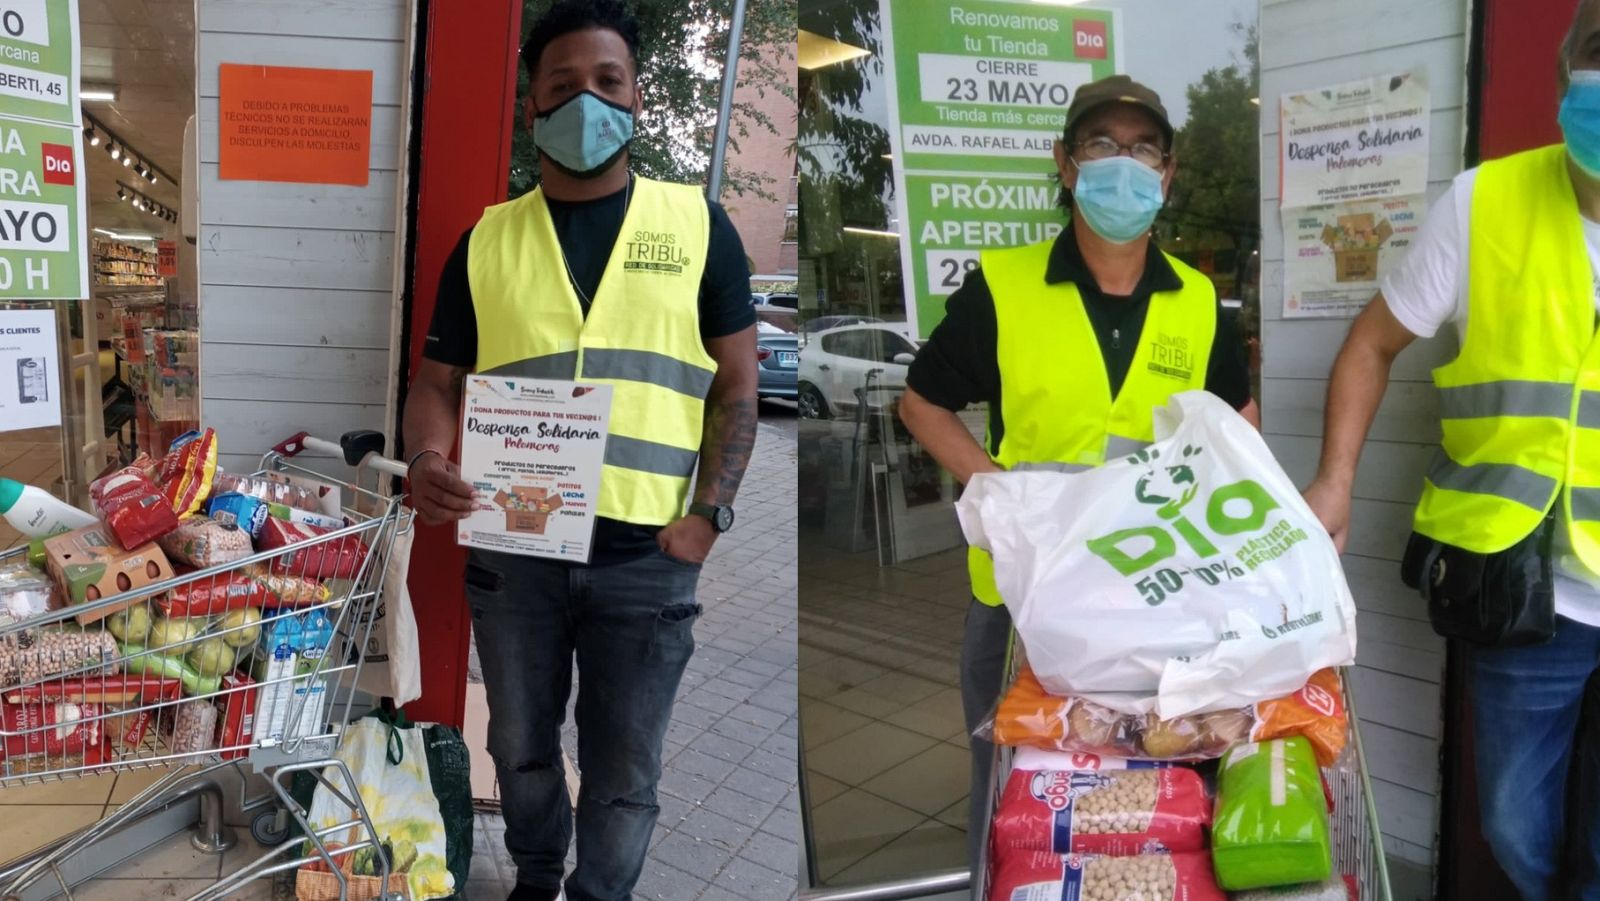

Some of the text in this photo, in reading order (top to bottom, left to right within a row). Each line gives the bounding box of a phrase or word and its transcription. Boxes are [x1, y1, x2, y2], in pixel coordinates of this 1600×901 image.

[950, 7, 1059, 32] Renovamos
[964, 35, 1048, 57] tu Tienda
[976, 60, 1038, 76] CIERRE
[46, 82, 62, 96] 45
[946, 78, 1069, 106] 23 MAYO
[242, 100, 350, 113] DEBIDO A PROBLEMAS
[936, 106, 988, 123] Tienda
[992, 109, 1022, 125] más
[275, 114, 290, 124] NO
[292, 115, 305, 125] SE
[238, 125, 291, 137] SERVICIOS
[292, 128, 299, 136] A
[229, 137, 361, 151] DISCULPEN LAS MOLESTIAS
[912, 133, 957, 148] AVDA.
[962, 135, 1020, 150] RAFAEL
[1289, 126, 1423, 160] Despensa Solidaria
[1326, 155, 1383, 172] Palomeras
[634, 230, 676, 244] SOMOS
[626, 242, 682, 263] TRIBU
[25, 258, 49, 290] H
[1158, 331, 1188, 349] SOMOS
[1151, 342, 1194, 370] TRIBU
[494, 408, 531, 416] PRODUCTOS
[533, 410, 550, 418] PARA
[553, 411, 564, 419] TUS
[467, 416, 600, 440] Despensa Solidaria
[504, 436, 560, 453] Palomeras
[1235, 519, 1292, 562] PLÁSTICO
[1134, 560, 1245, 607] 50-0%
